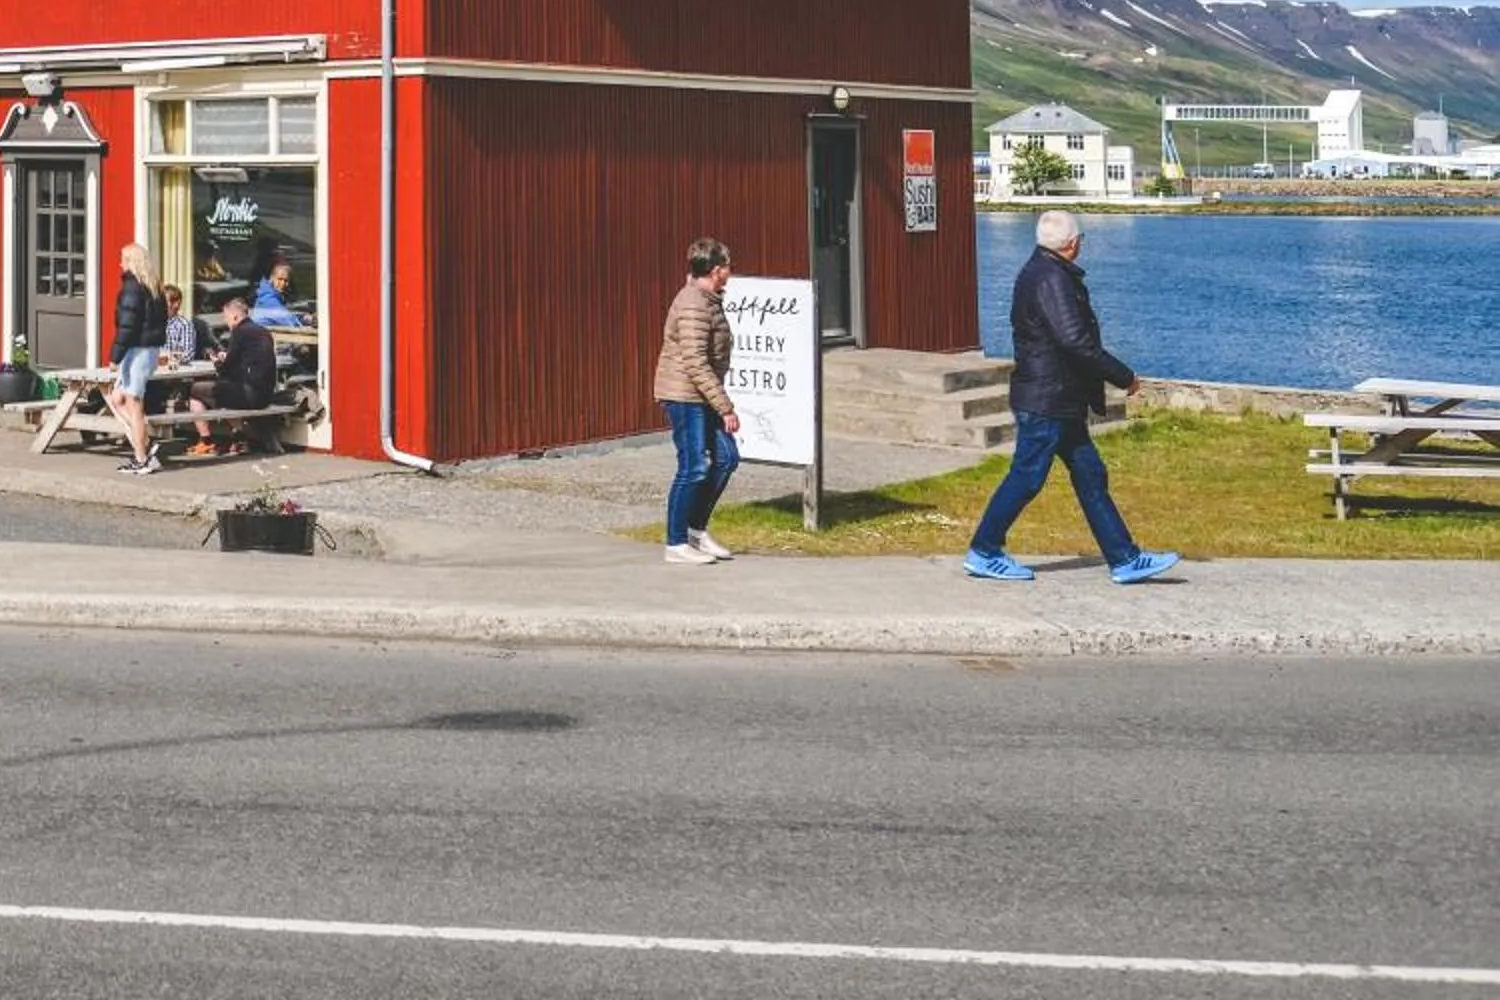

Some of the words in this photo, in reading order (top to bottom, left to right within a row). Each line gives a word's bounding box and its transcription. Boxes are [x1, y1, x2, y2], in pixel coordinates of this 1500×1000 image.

[906, 178, 936, 205] Sushi
[206, 196, 259, 225] Nordic
[725, 296, 801, 326] aftfell
[731, 334, 786, 353] LLERY
[728, 367, 787, 391] ISTRO
